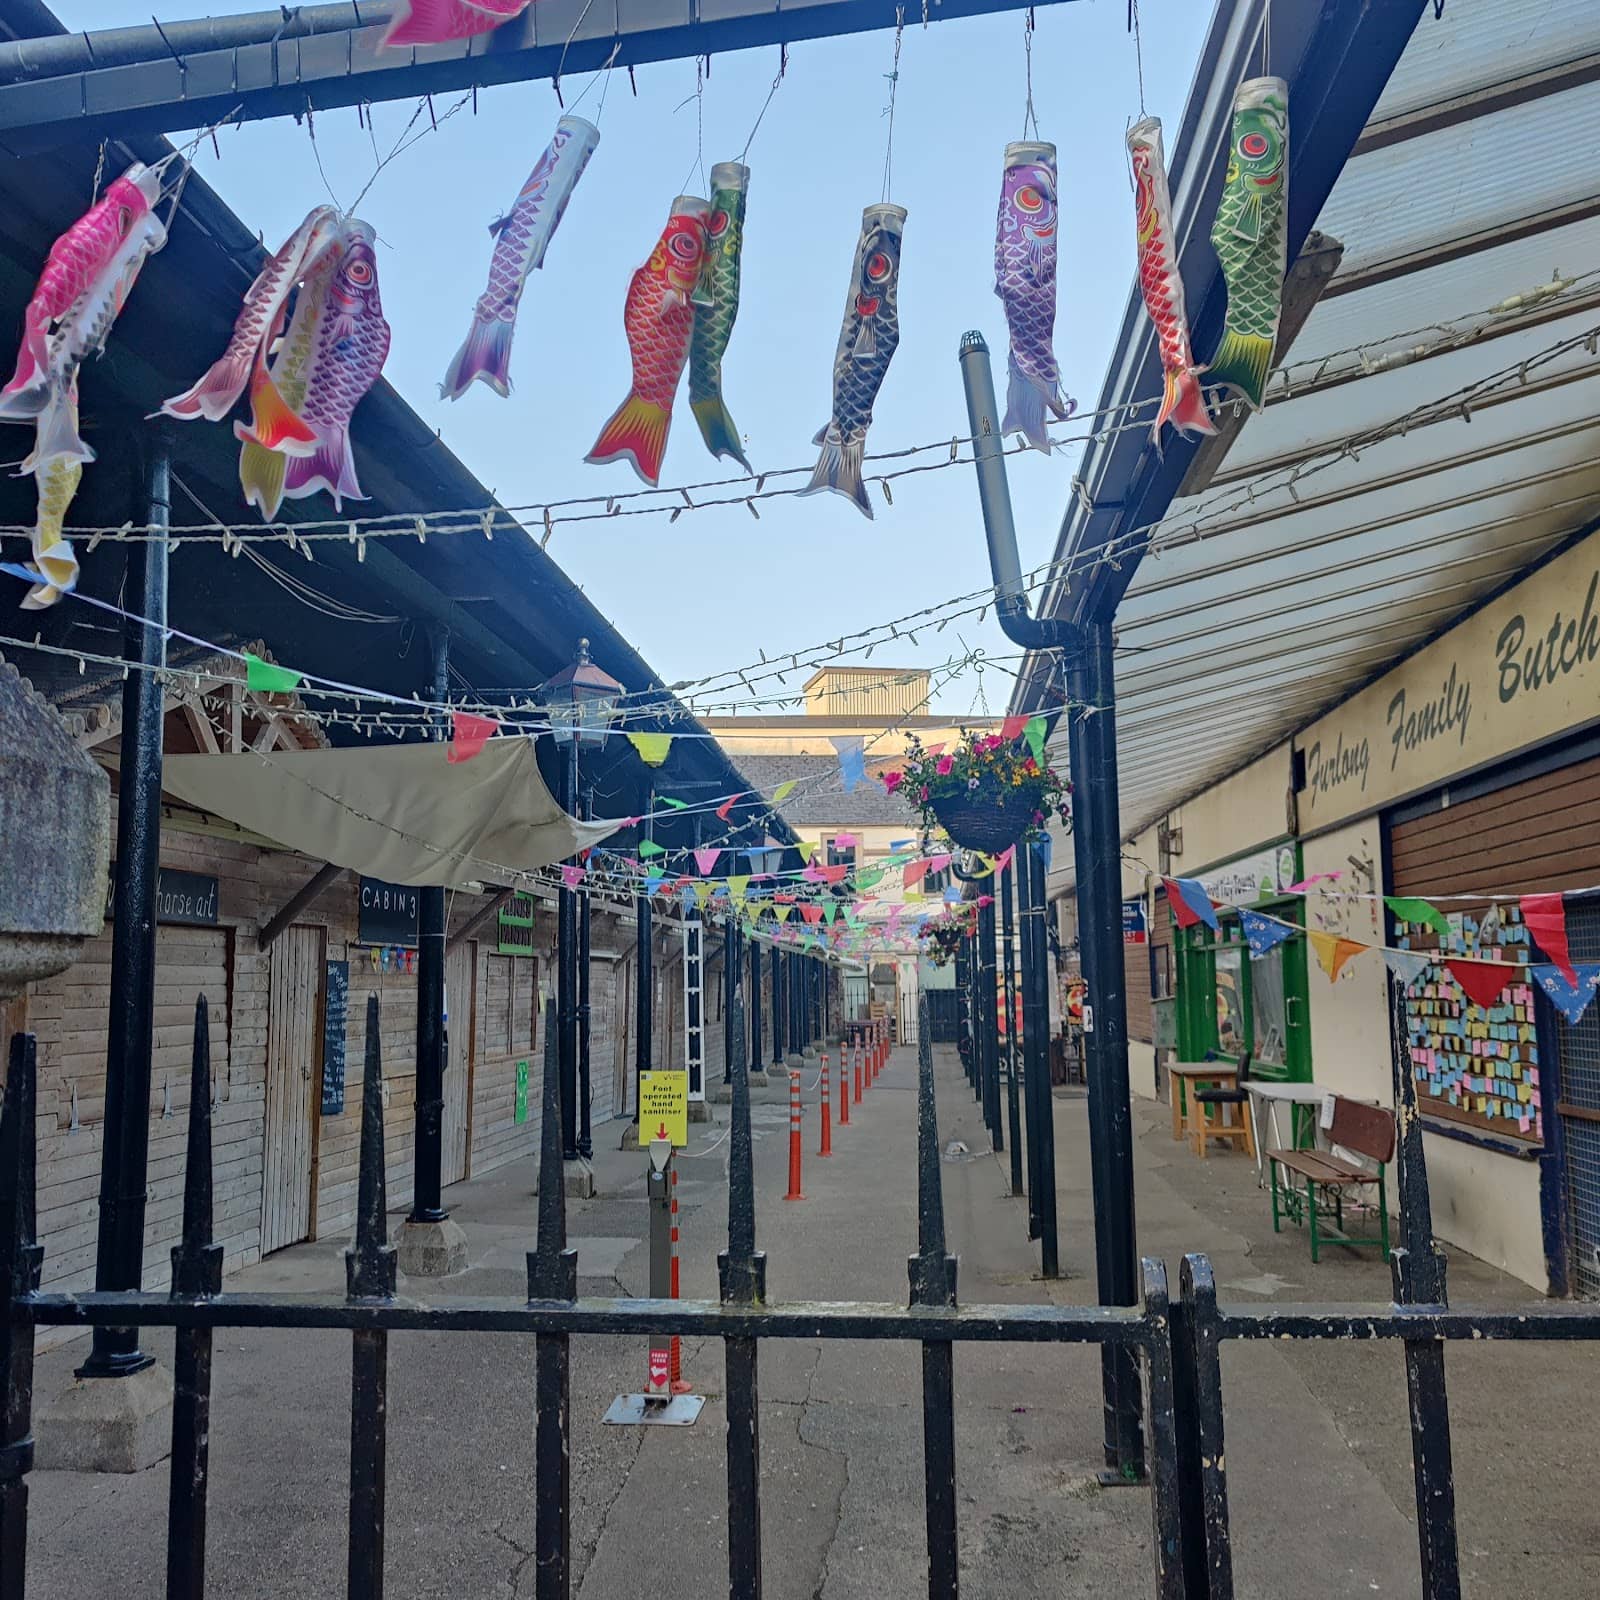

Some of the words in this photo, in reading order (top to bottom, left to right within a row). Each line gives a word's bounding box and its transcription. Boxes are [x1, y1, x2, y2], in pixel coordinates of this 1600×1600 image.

[1308, 731, 1370, 808] Furlong
[1387, 661, 1472, 772] Family
[155, 874, 191, 915] horse
[196, 882, 214, 918] art
[362, 886, 406, 912] CABIN
[410, 895, 416, 919] 3
[643, 1092, 682, 1100] operated
